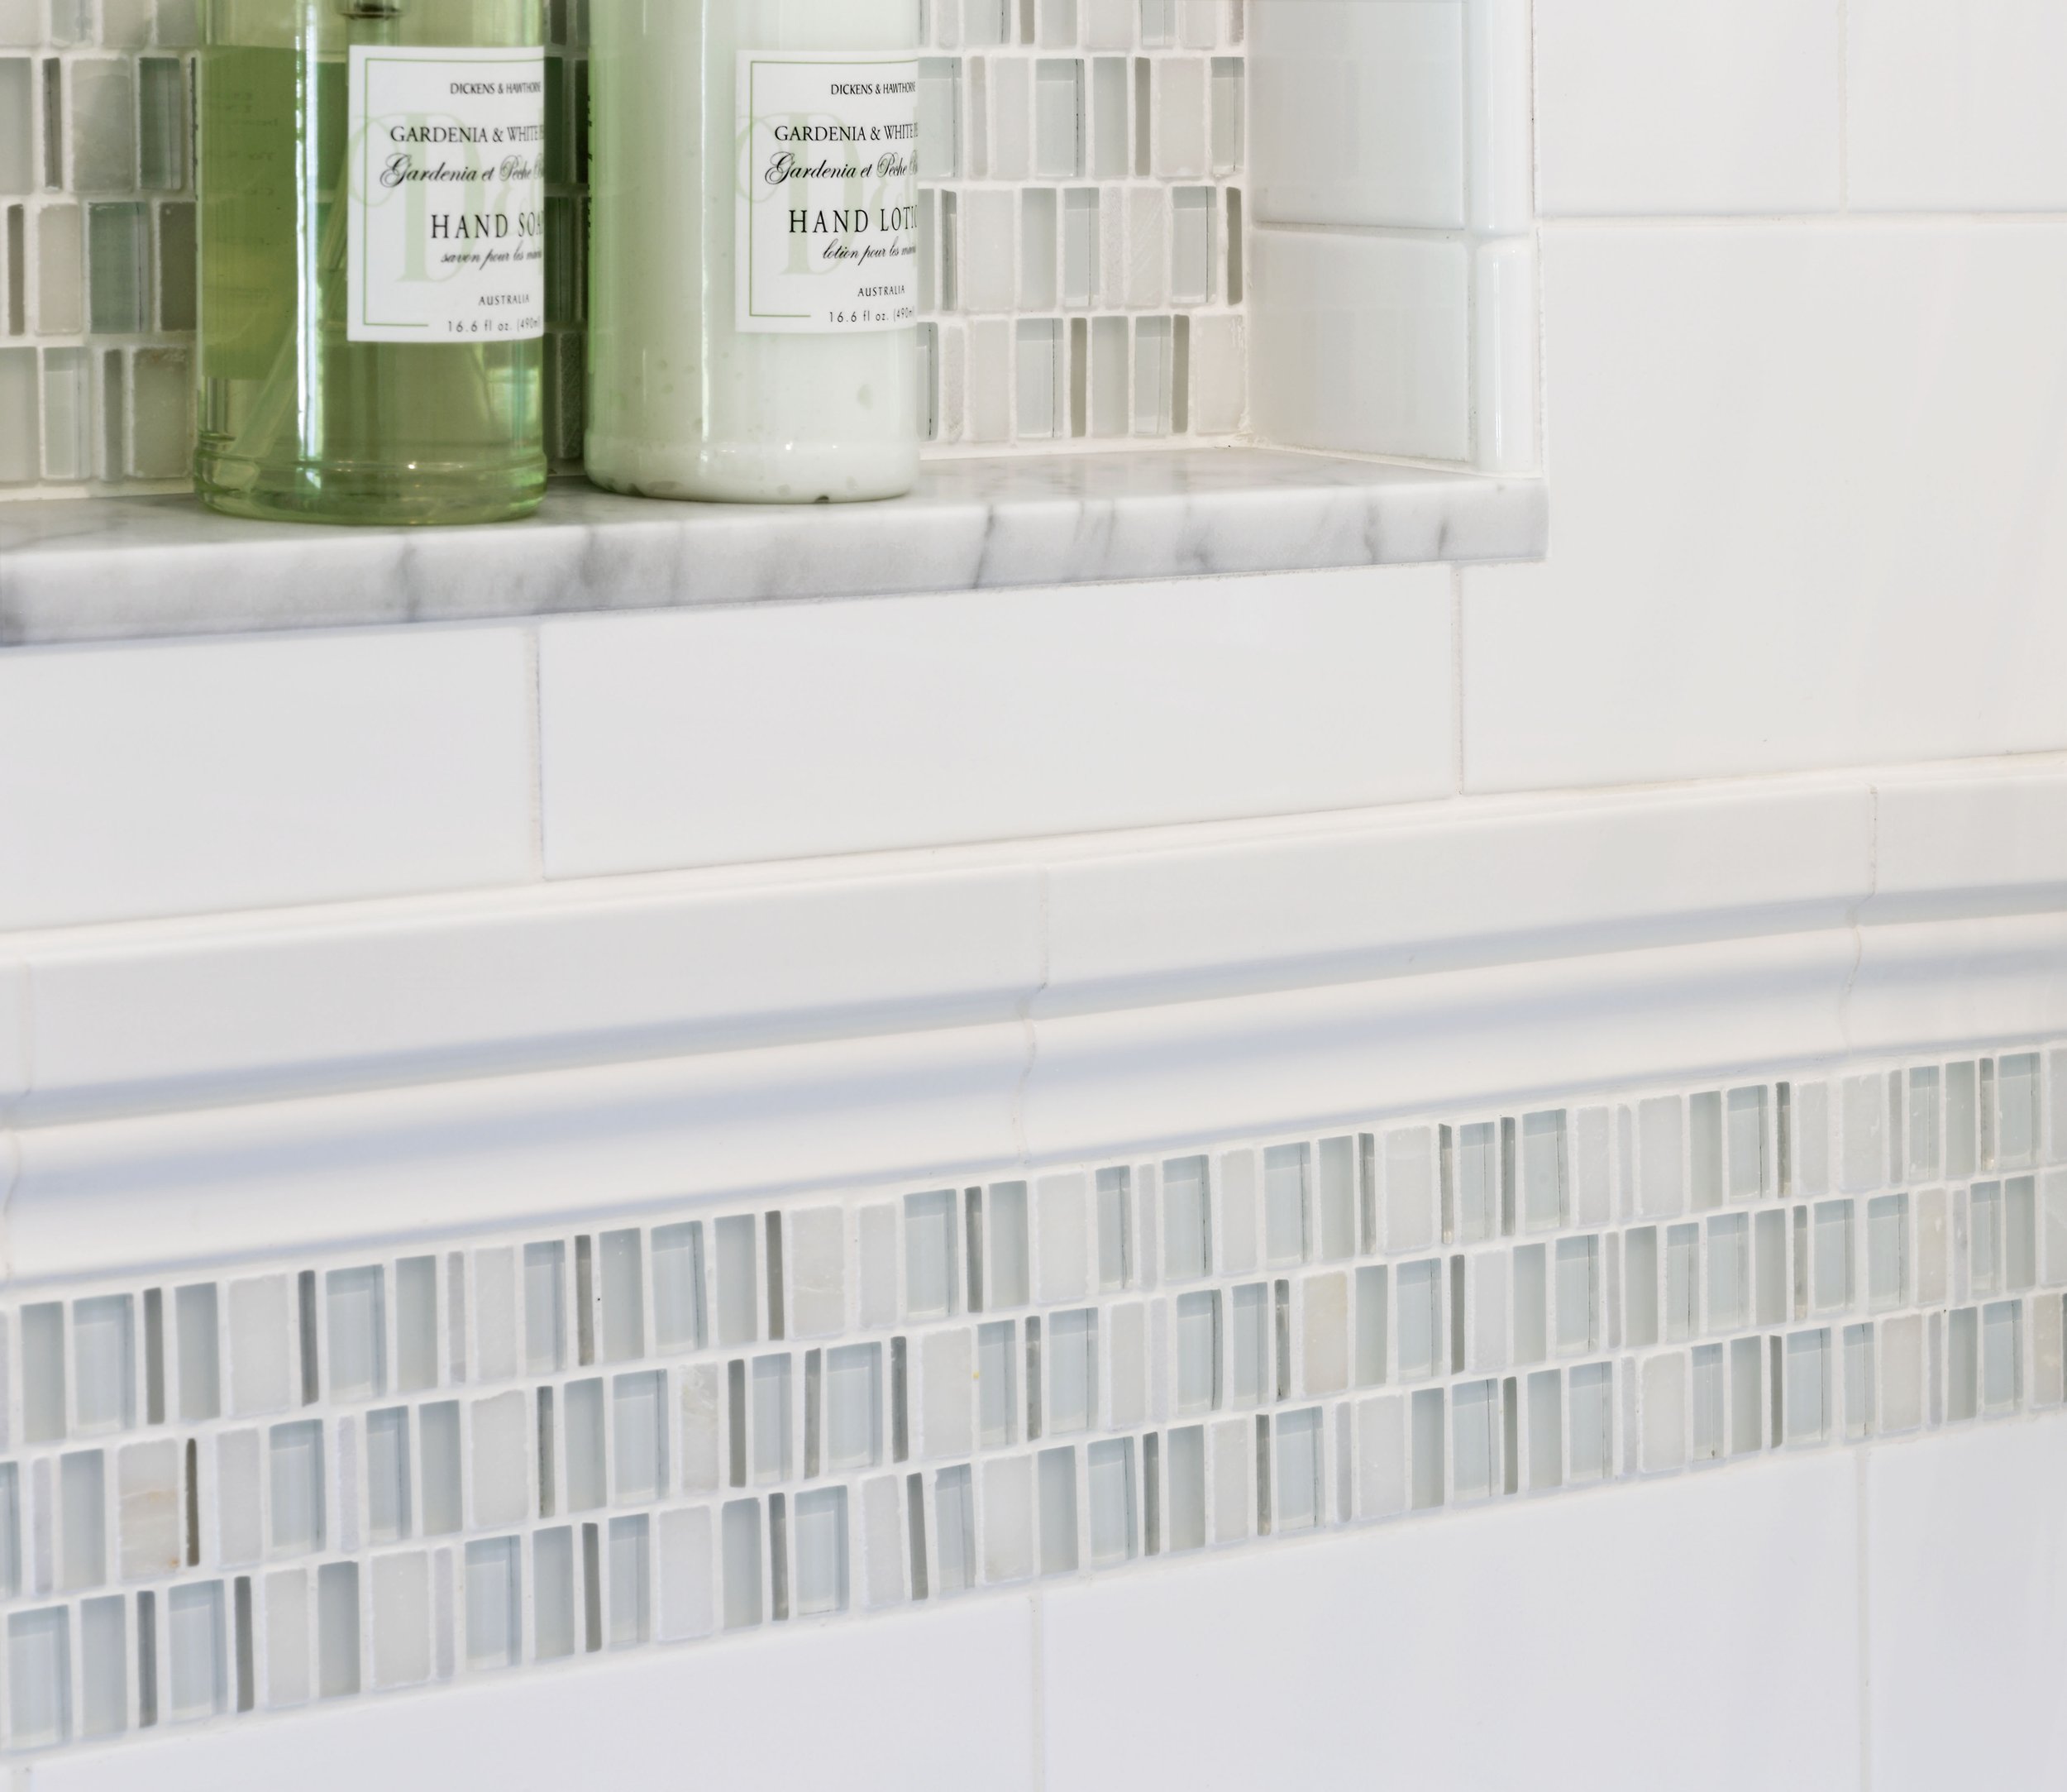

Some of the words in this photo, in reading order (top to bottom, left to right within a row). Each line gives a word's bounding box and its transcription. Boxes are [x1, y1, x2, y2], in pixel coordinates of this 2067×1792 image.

[450, 82, 495, 94] DICKENS
[498, 83, 505, 94] &
[830, 84, 873, 95] DICKENS
[875, 84, 881, 94] &
[390, 126, 488, 143] GARDENIA
[492, 127, 504, 142] &
[507, 126, 538, 142] WHITE
[774, 125, 866, 141] GARDENIA
[870, 127, 881, 141] &
[883, 123, 913, 140] WHITE
[380, 152, 478, 188] Gardenia
[481, 165, 495, 181] et
[764, 151, 857, 184] Gardenia
[860, 163, 873, 178] et
[431, 213, 508, 239] HAND
[789, 209, 869, 233] HAND
[441, 251, 481, 263] savon
[479, 249, 510, 271] pour
[513, 240, 524, 261] les
[823, 238, 859, 260] lotion
[857, 245, 886, 266] pour
[889, 236, 900, 257] les
[857, 284, 905, 297] AUSTRALIA
[478, 294, 530, 306] AUSTRALIA
[829, 311, 857, 323] 16.6
[863, 310, 871, 322] fl
[875, 313, 889, 322] oz.
[447, 320, 478, 332] 16.6
[484, 319, 493, 332] fl
